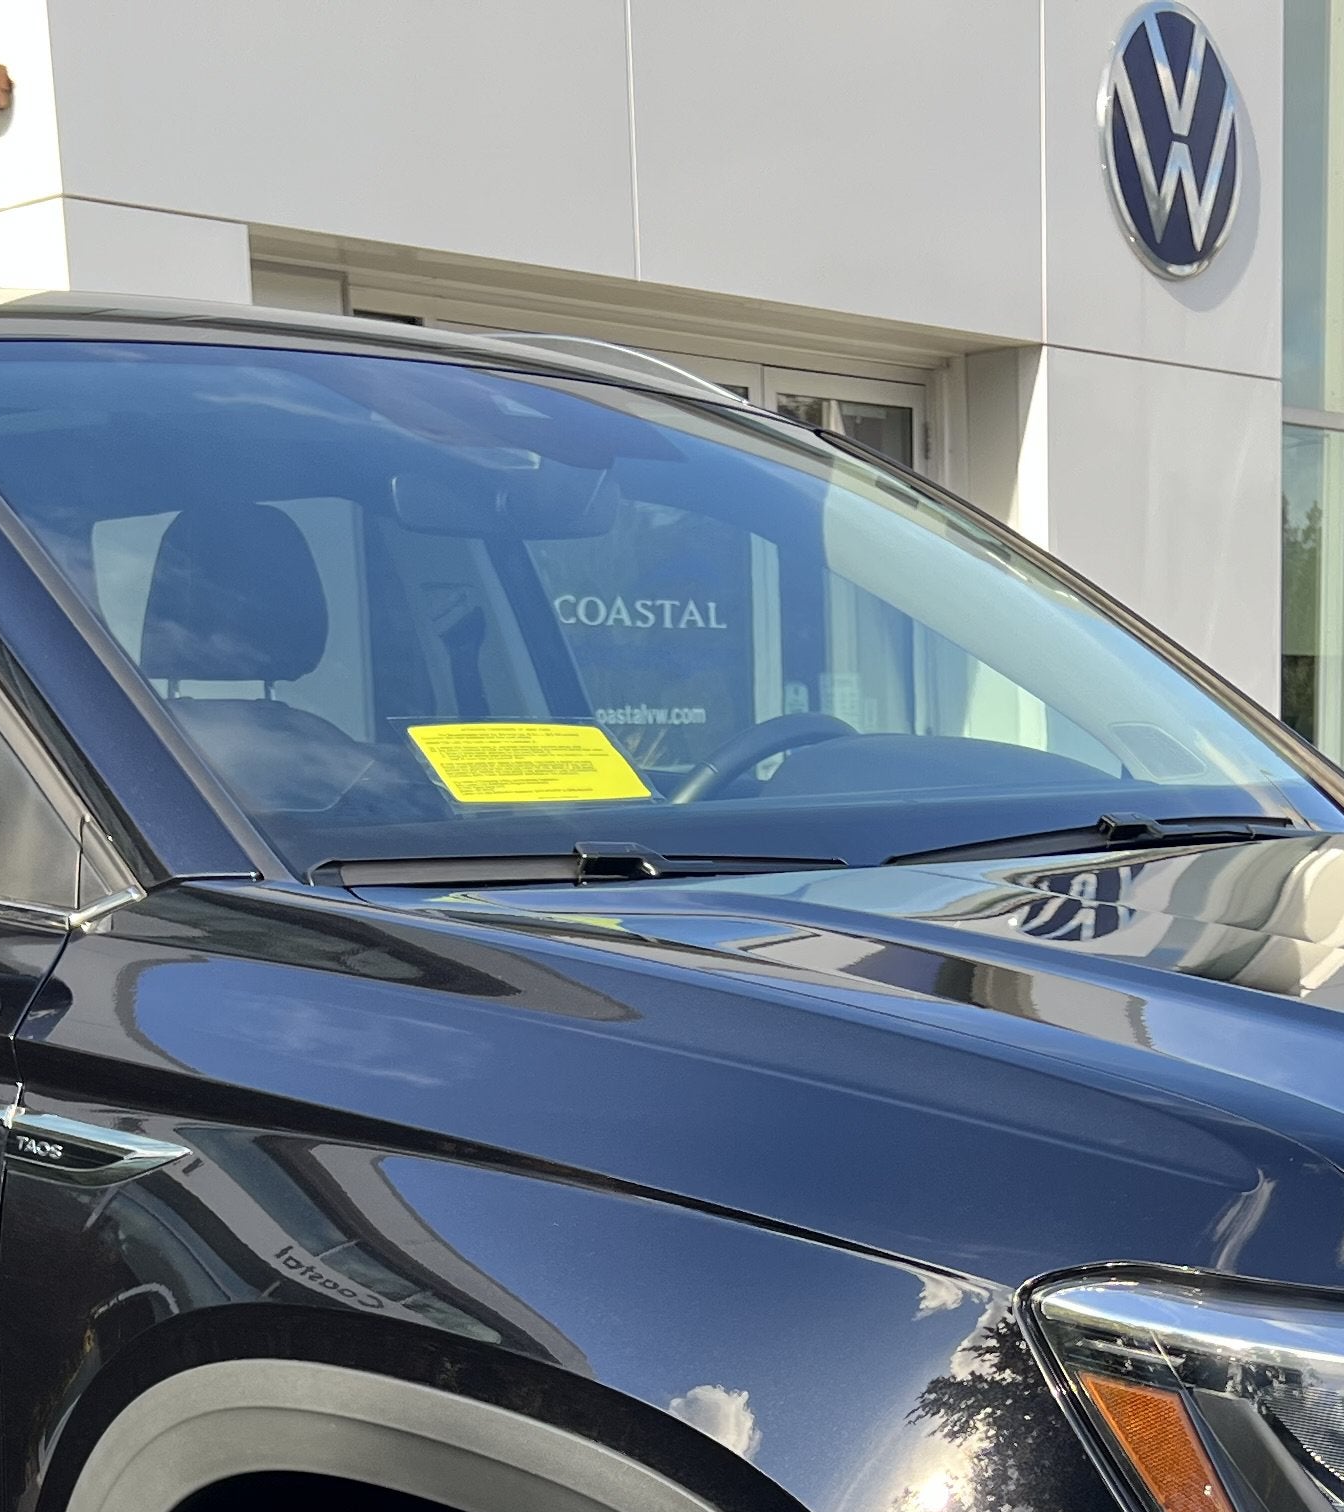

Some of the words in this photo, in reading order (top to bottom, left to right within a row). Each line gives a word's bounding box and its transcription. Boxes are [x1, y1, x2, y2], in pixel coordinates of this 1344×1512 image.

[1105, 4, 1240, 268] VW
[554, 594, 727, 629] COASTAL
[595, 704, 706, 725] oastalvw.com
[16, 1135, 63, 1160] TAOS
